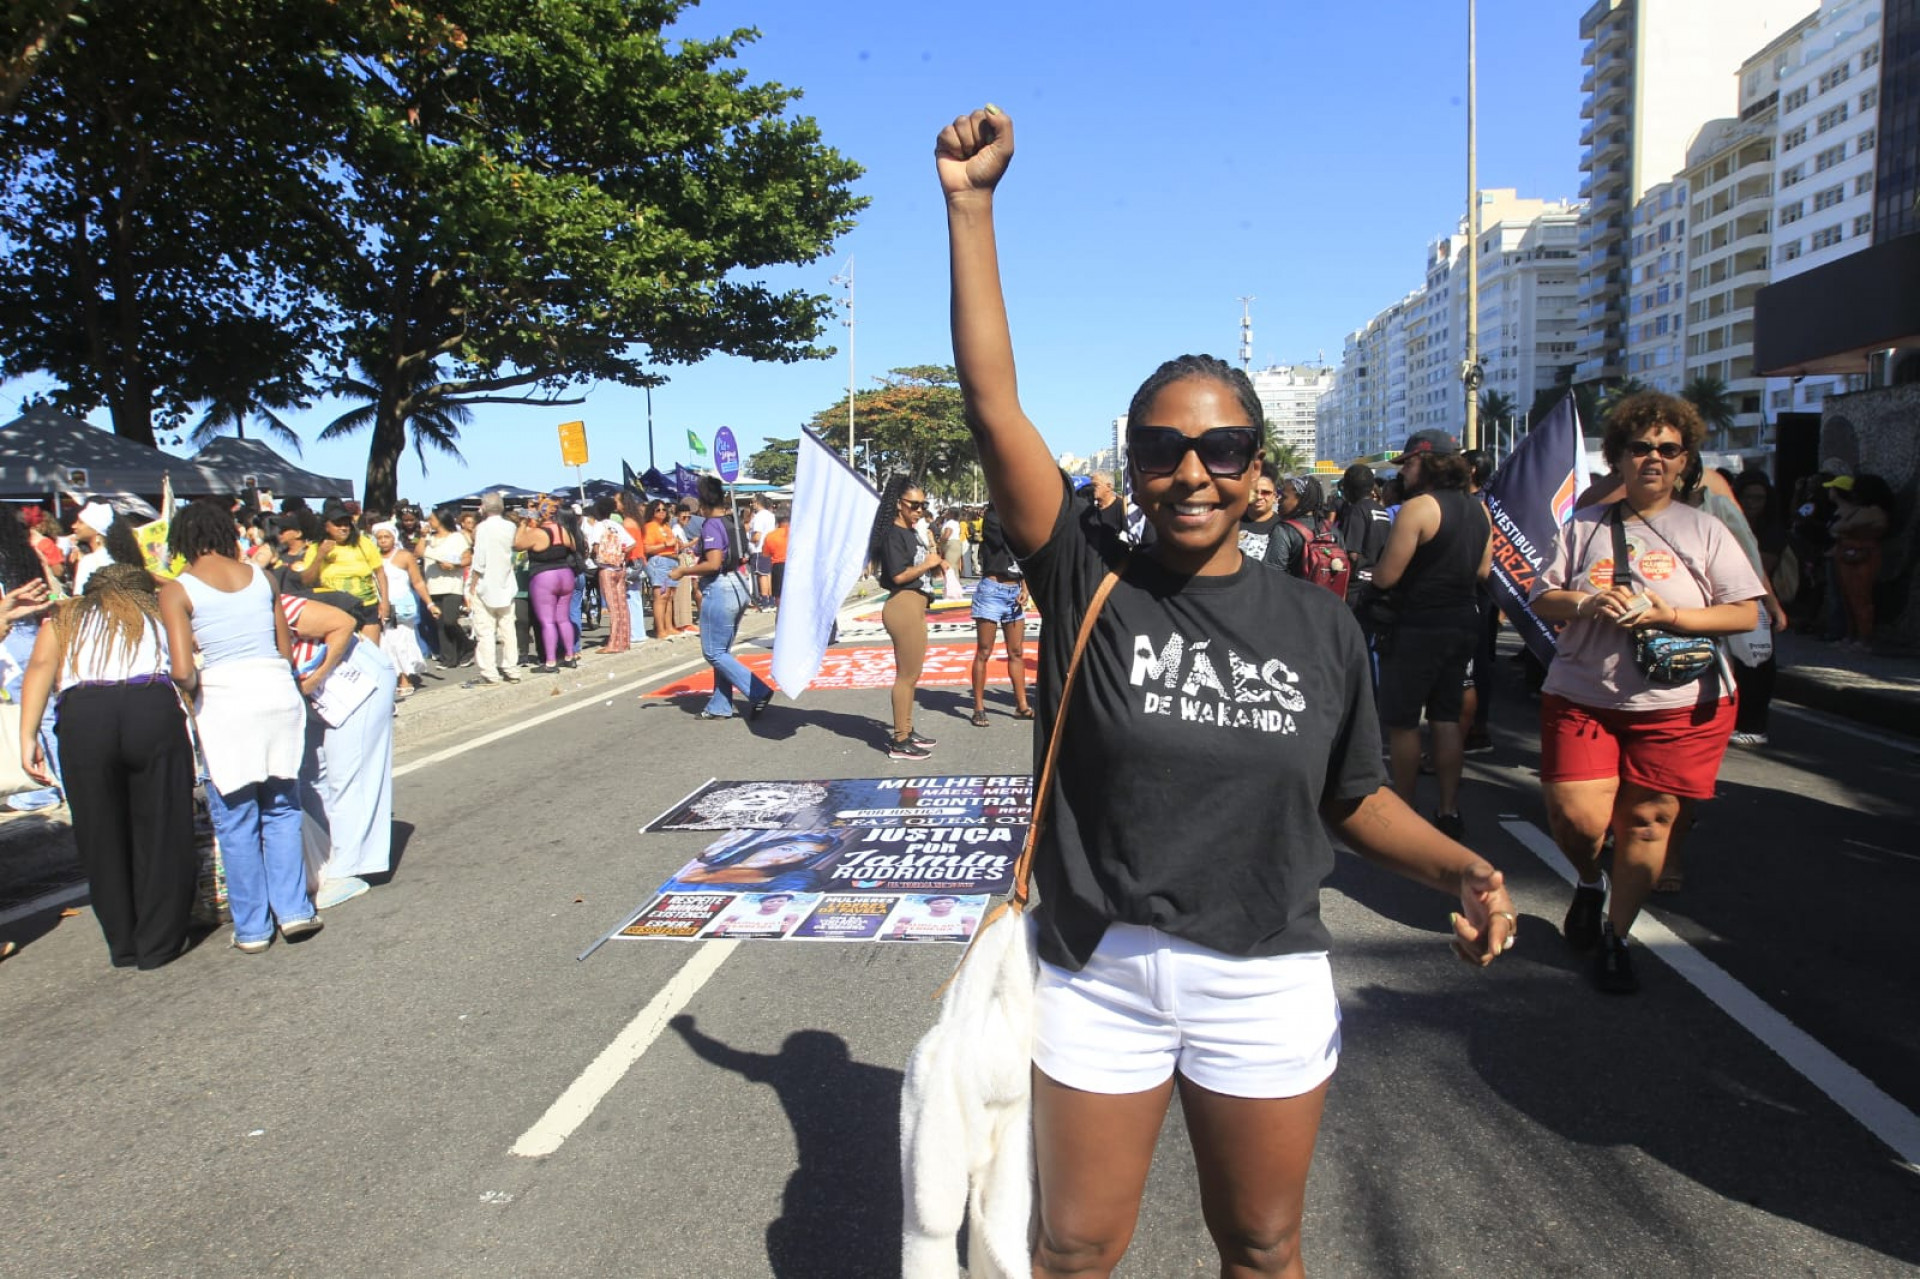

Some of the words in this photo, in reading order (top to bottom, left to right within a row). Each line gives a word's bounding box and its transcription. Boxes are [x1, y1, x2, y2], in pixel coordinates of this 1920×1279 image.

[1143, 692, 1173, 715] DE
[1180, 696, 1298, 735] WAKANDA
[983, 787, 1032, 796] MENI
[916, 797, 1017, 806] CONTRA
[848, 817, 900, 826] FAZ
[905, 816, 987, 826] QUEM
[862, 827, 1012, 844] JUSTIÇA
[905, 842, 957, 854] POR
[830, 865, 1006, 880] RODRIGUES
